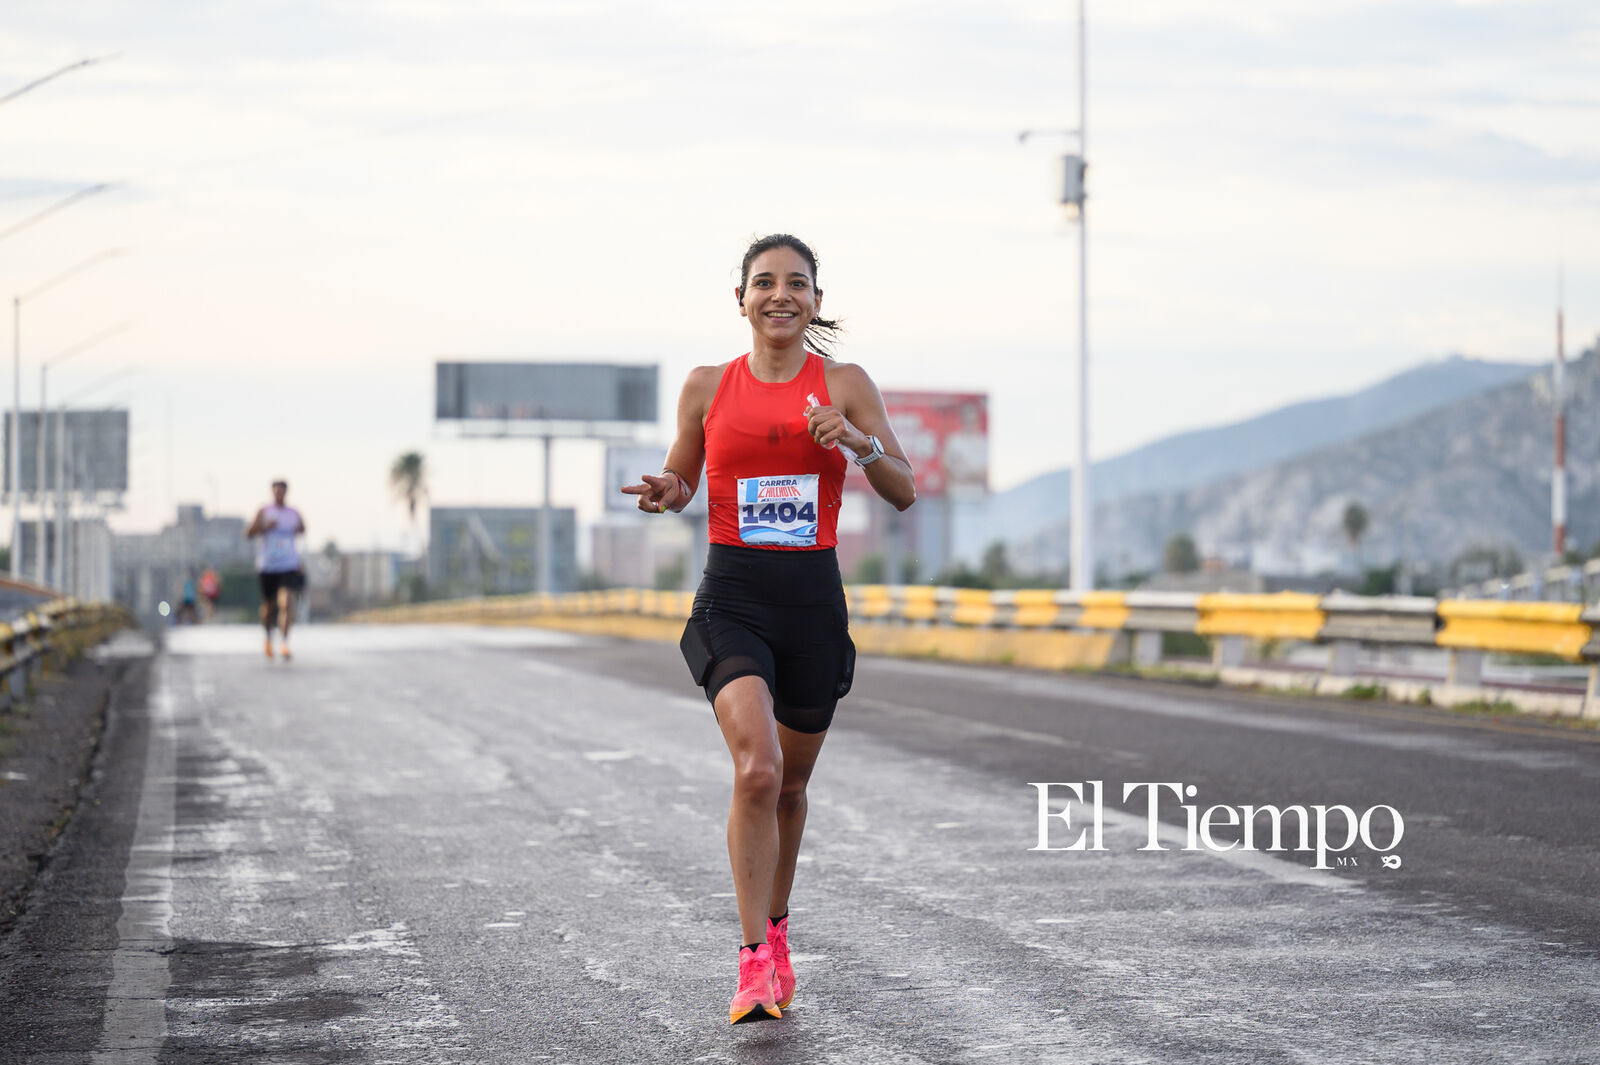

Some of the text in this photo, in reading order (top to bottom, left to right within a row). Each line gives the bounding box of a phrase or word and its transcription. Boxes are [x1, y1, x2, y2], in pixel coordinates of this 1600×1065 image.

[759, 479, 798, 487] CARRERA
[758, 486, 802, 498] CHILCHOTA
[742, 502, 816, 524] 1404
